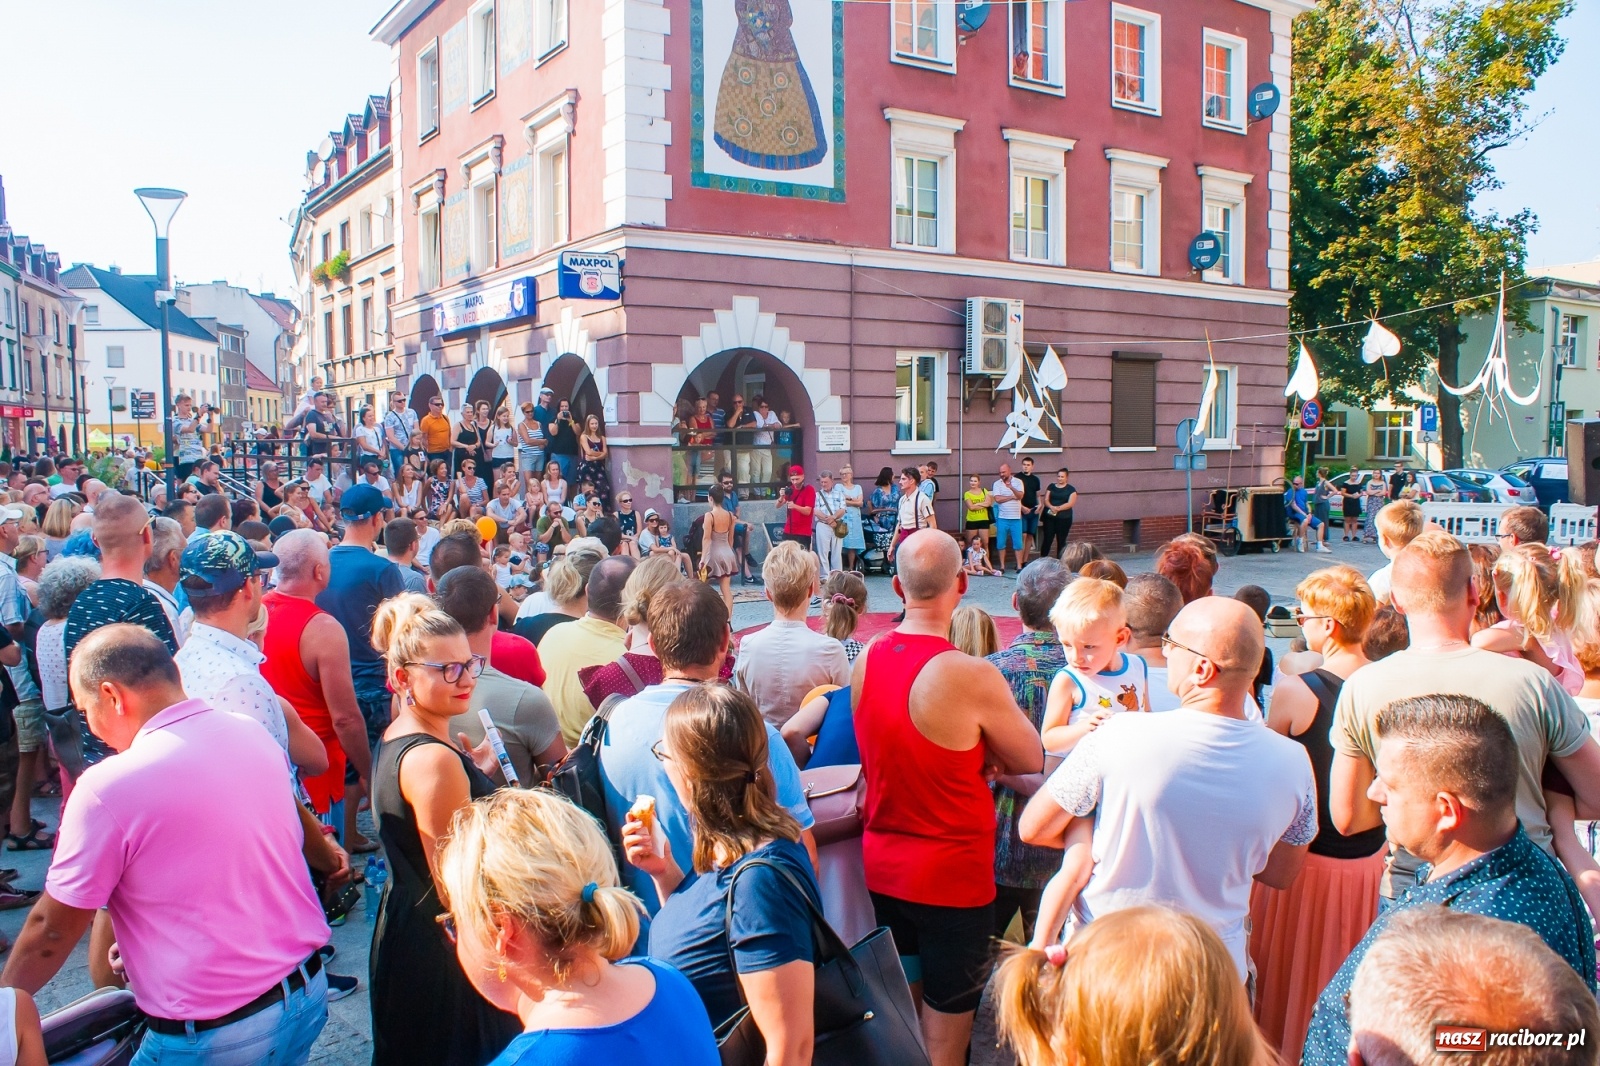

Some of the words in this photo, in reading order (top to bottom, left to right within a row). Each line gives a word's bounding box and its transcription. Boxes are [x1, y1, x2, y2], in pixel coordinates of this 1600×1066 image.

[569, 257, 614, 269] MAXPOL
[464, 294, 486, 309] MAXPOL
[1424, 408, 1434, 424] P
